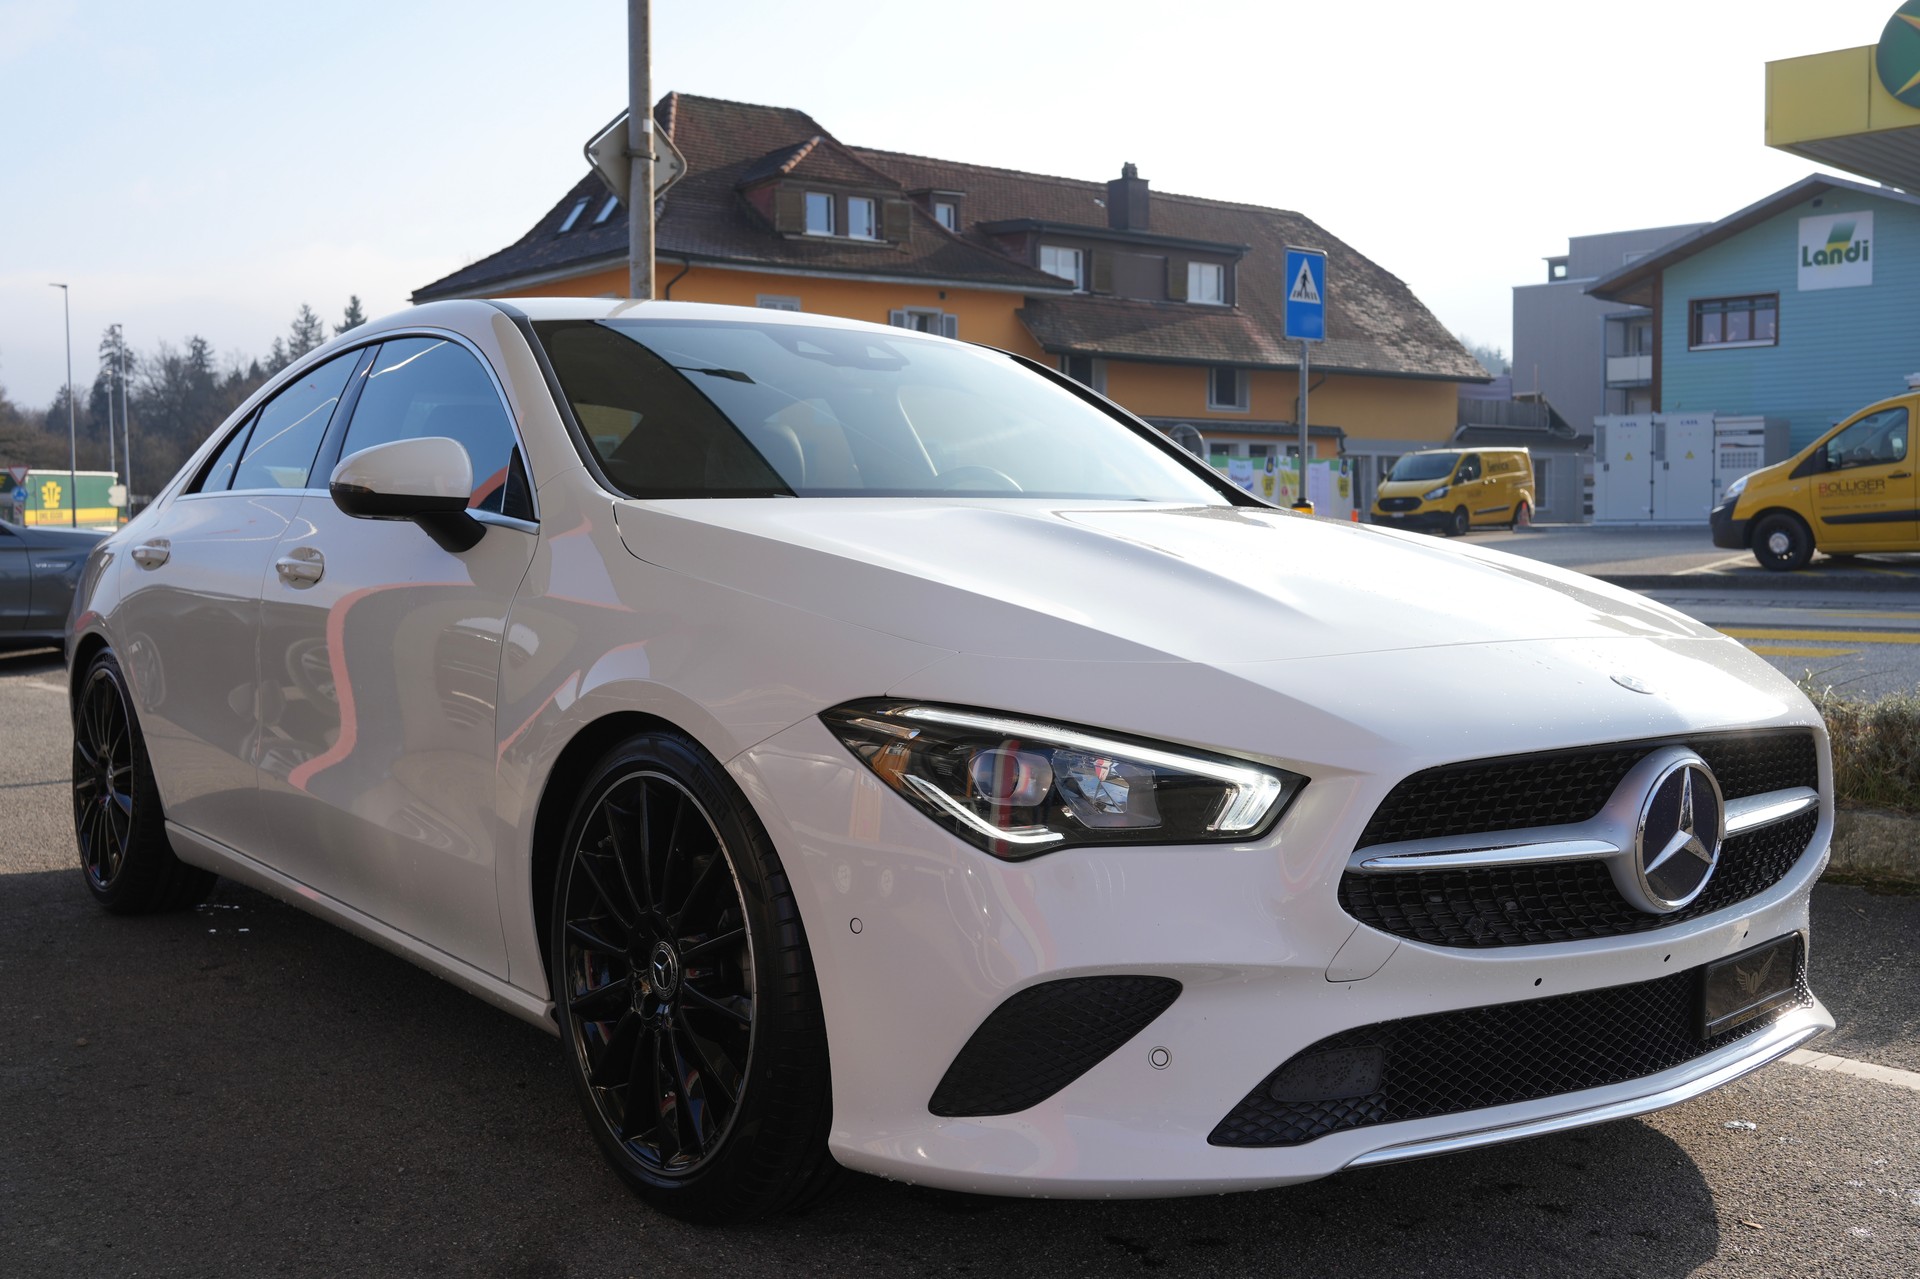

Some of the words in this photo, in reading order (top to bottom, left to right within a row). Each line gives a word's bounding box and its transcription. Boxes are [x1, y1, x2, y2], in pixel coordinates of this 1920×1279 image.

[1802, 240, 1869, 267] Landi
[1818, 479, 1886, 494] BOLLIGER
[692, 764, 731, 822] PIRELLI
